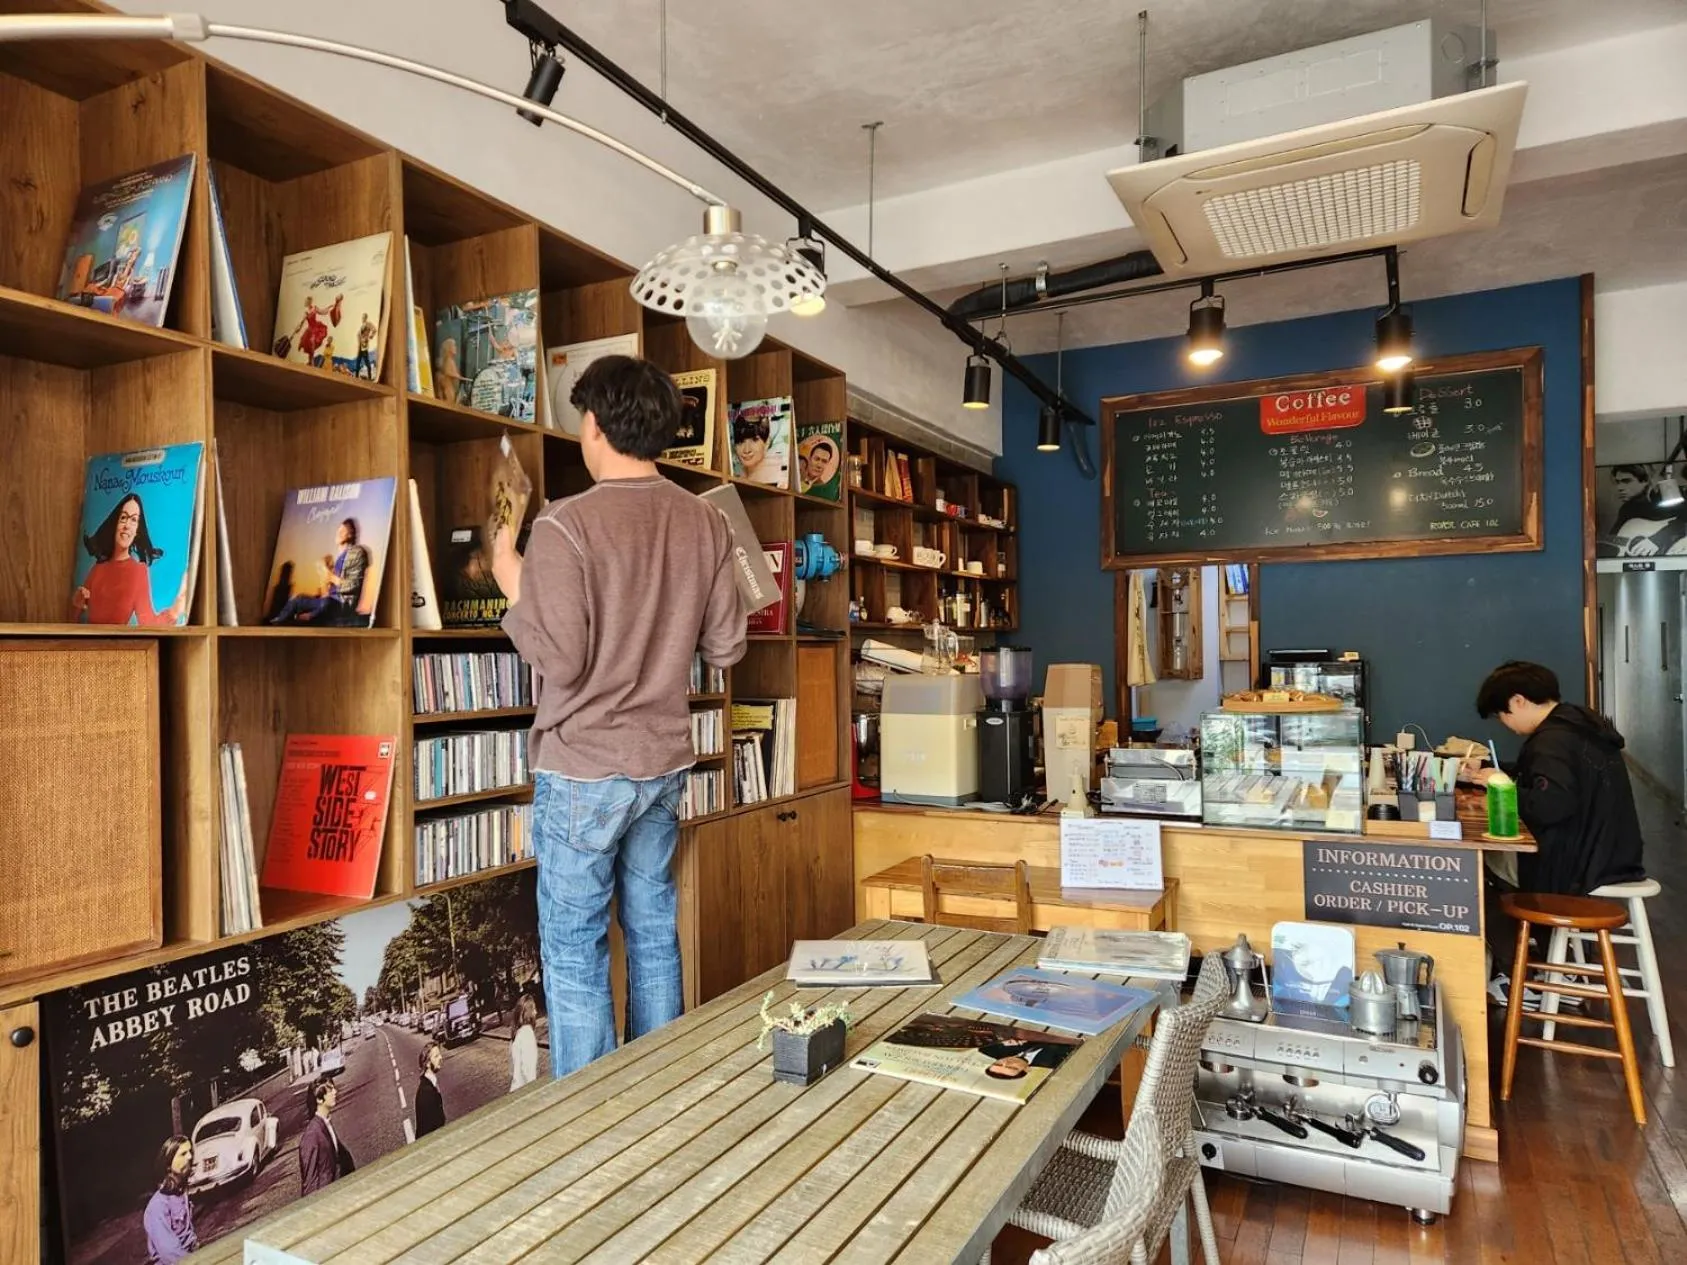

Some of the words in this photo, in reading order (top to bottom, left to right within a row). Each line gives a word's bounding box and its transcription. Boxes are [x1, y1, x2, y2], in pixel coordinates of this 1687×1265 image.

[1275, 391, 1352, 413] Coffee
[94, 467, 123, 494] Nana
[735, 547, 765, 599] Christmas
[319, 764, 367, 797] WEST
[312, 796, 357, 830] SIDE
[307, 828, 361, 863] STORY
[1318, 848, 1462, 872] INFORMATION
[1350, 880, 1428, 899] CASHIER
[1314, 894, 1372, 911] ORDER
[1387, 900, 1469, 919] PICK-UP
[84, 988, 138, 1020] THE
[146, 956, 251, 1003] BEATLES
[90, 1005, 176, 1052] ABBEY
[187, 983, 251, 1020] ROAD
